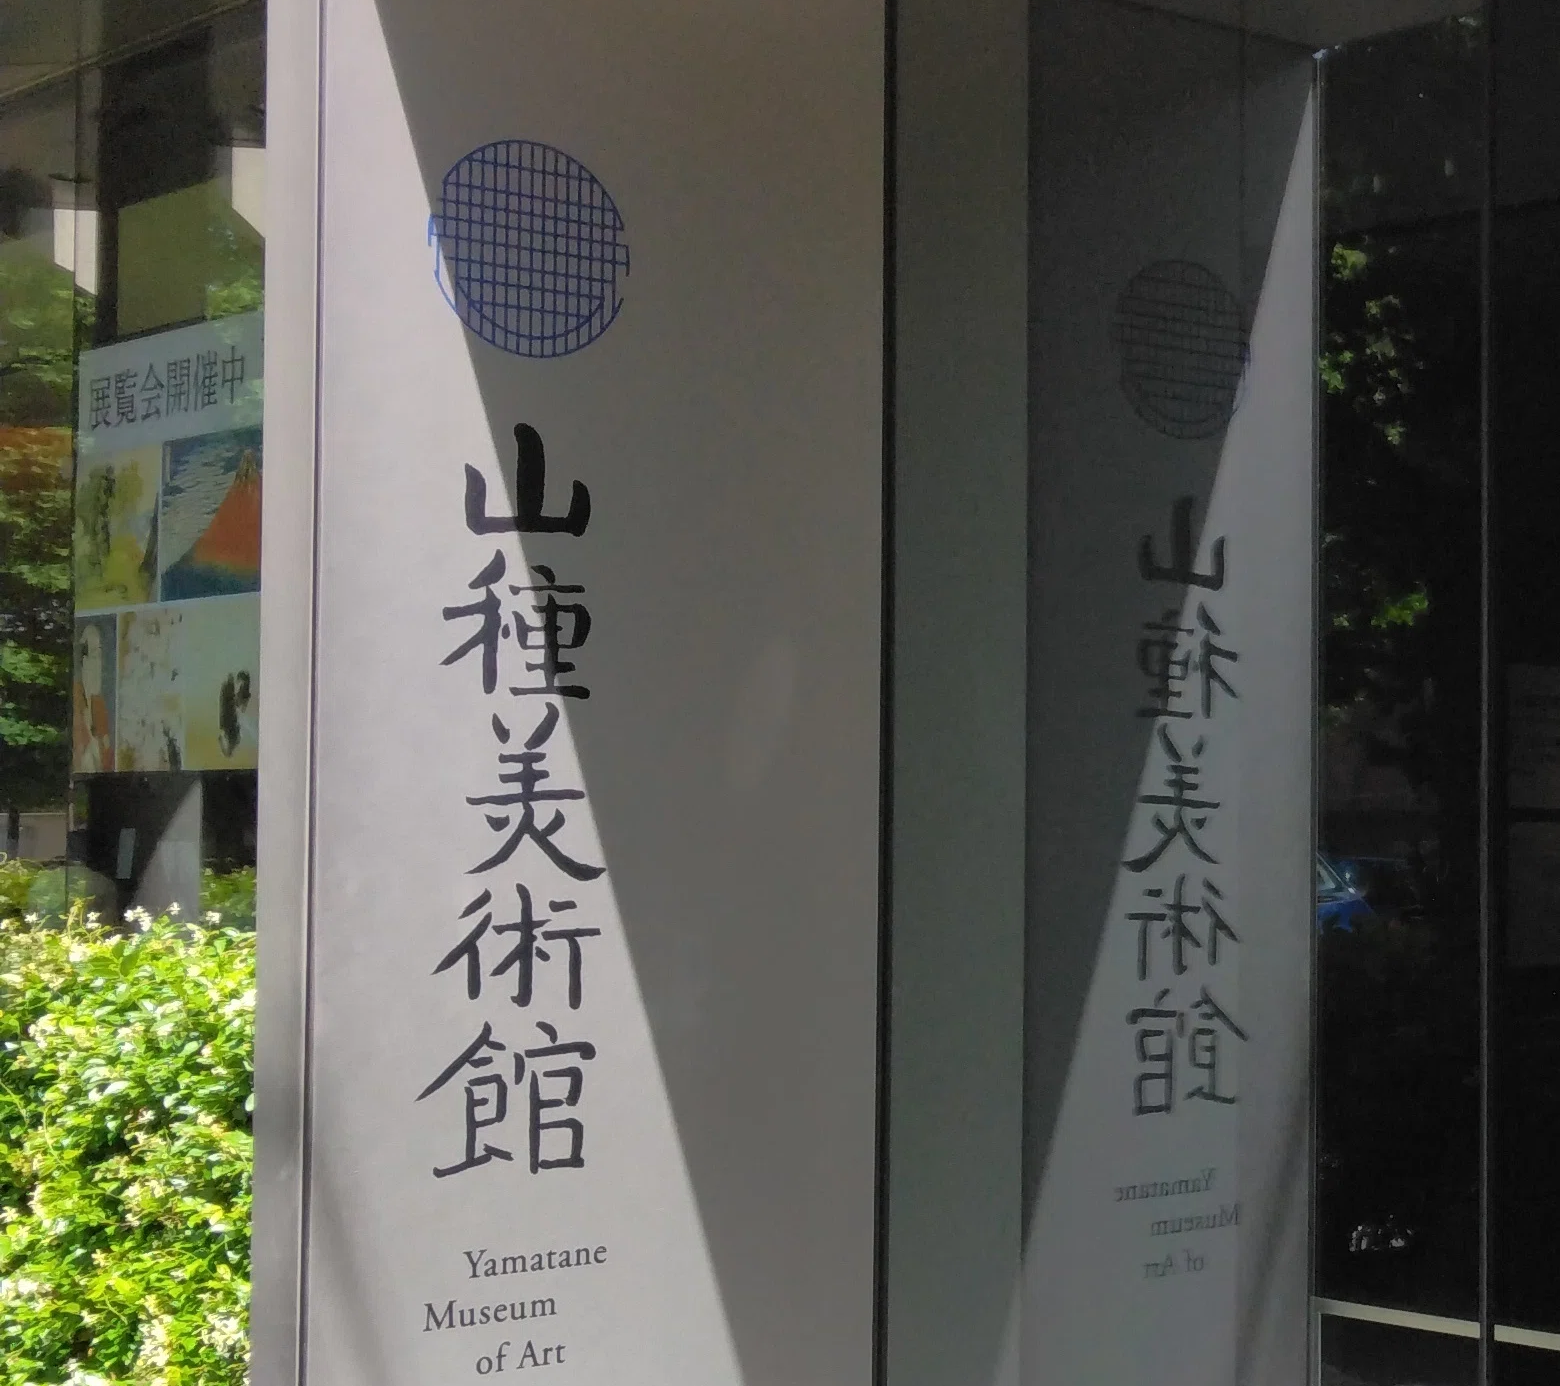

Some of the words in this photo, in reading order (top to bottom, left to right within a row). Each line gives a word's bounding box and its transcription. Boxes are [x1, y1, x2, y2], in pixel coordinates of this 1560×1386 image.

[89, 345, 246, 431] 展覧会開催中
[414, 422, 606, 1179] 山種美術館
[463, 1244, 607, 1279] Yamatane
[422, 1296, 557, 1332] Museum
[475, 1341, 510, 1375] of
[516, 1340, 566, 1369] Art
